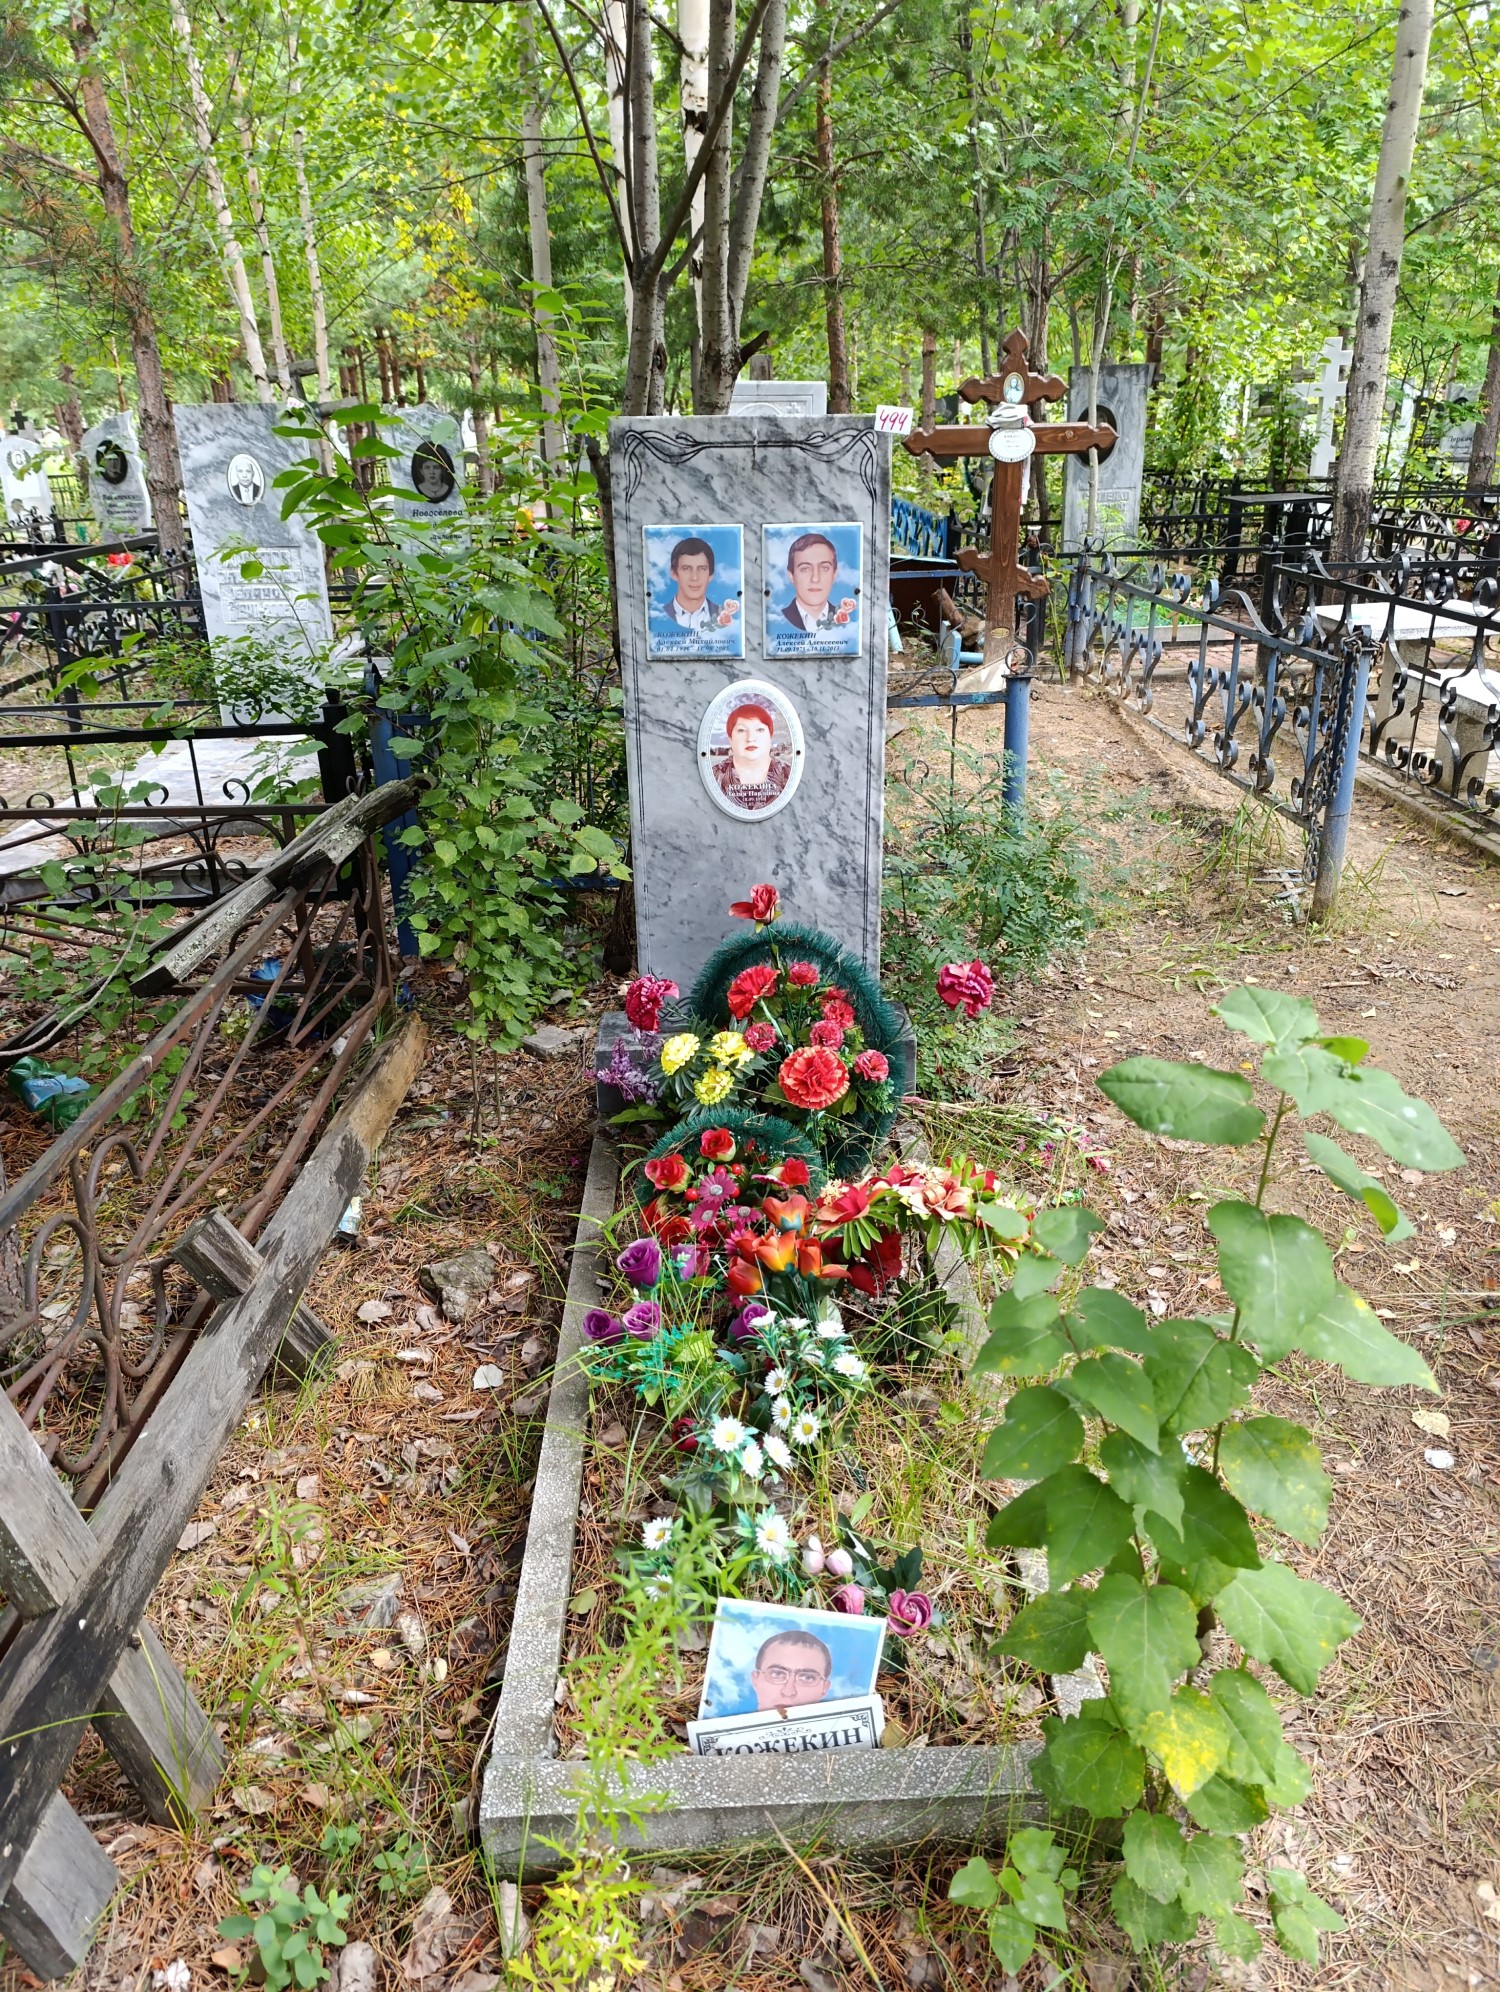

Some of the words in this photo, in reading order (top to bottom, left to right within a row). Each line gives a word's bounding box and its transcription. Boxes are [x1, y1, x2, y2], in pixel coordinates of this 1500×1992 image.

[879, 409, 909, 431] 494
[776, 632, 817, 640] КОЖЕКИН
[688, 638, 736, 646] Михайлович
[806, 639, 849, 647] Алексеевич
